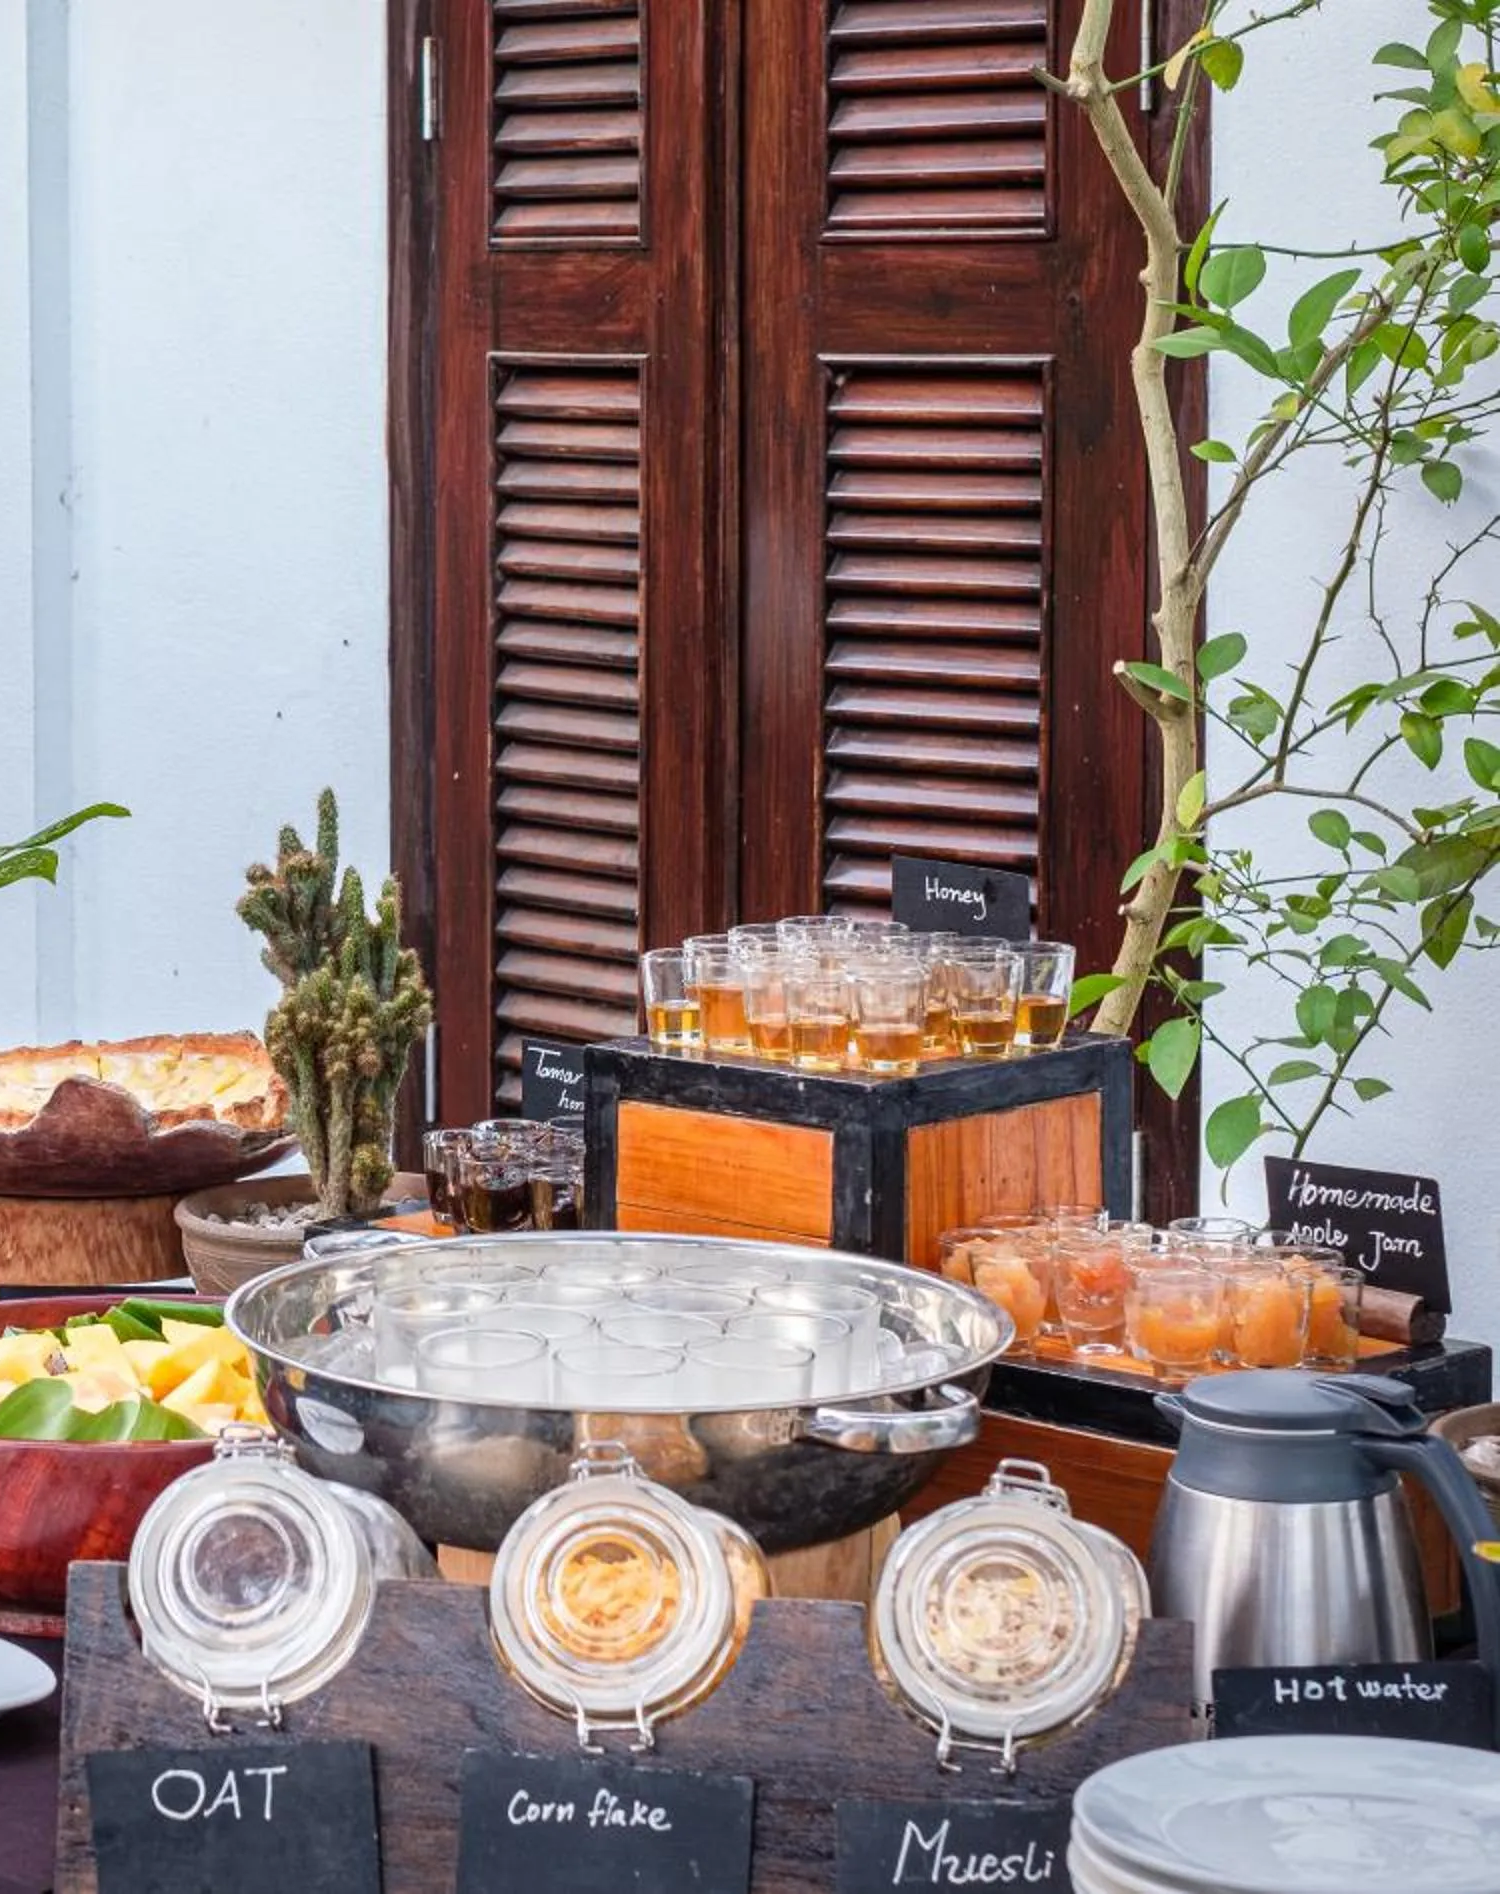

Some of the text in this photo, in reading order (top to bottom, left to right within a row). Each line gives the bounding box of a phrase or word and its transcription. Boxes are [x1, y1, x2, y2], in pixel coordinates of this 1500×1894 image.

[924, 875, 987, 920] Honey
[1288, 1168, 1437, 1215] Homemade
[1358, 1230, 1424, 1272] Jam
[1355, 1672, 1449, 1701] water
[151, 1764, 288, 1821] OAT
[507, 1787, 673, 1832] Corn flake
[892, 1818, 1056, 1886] Muesli
